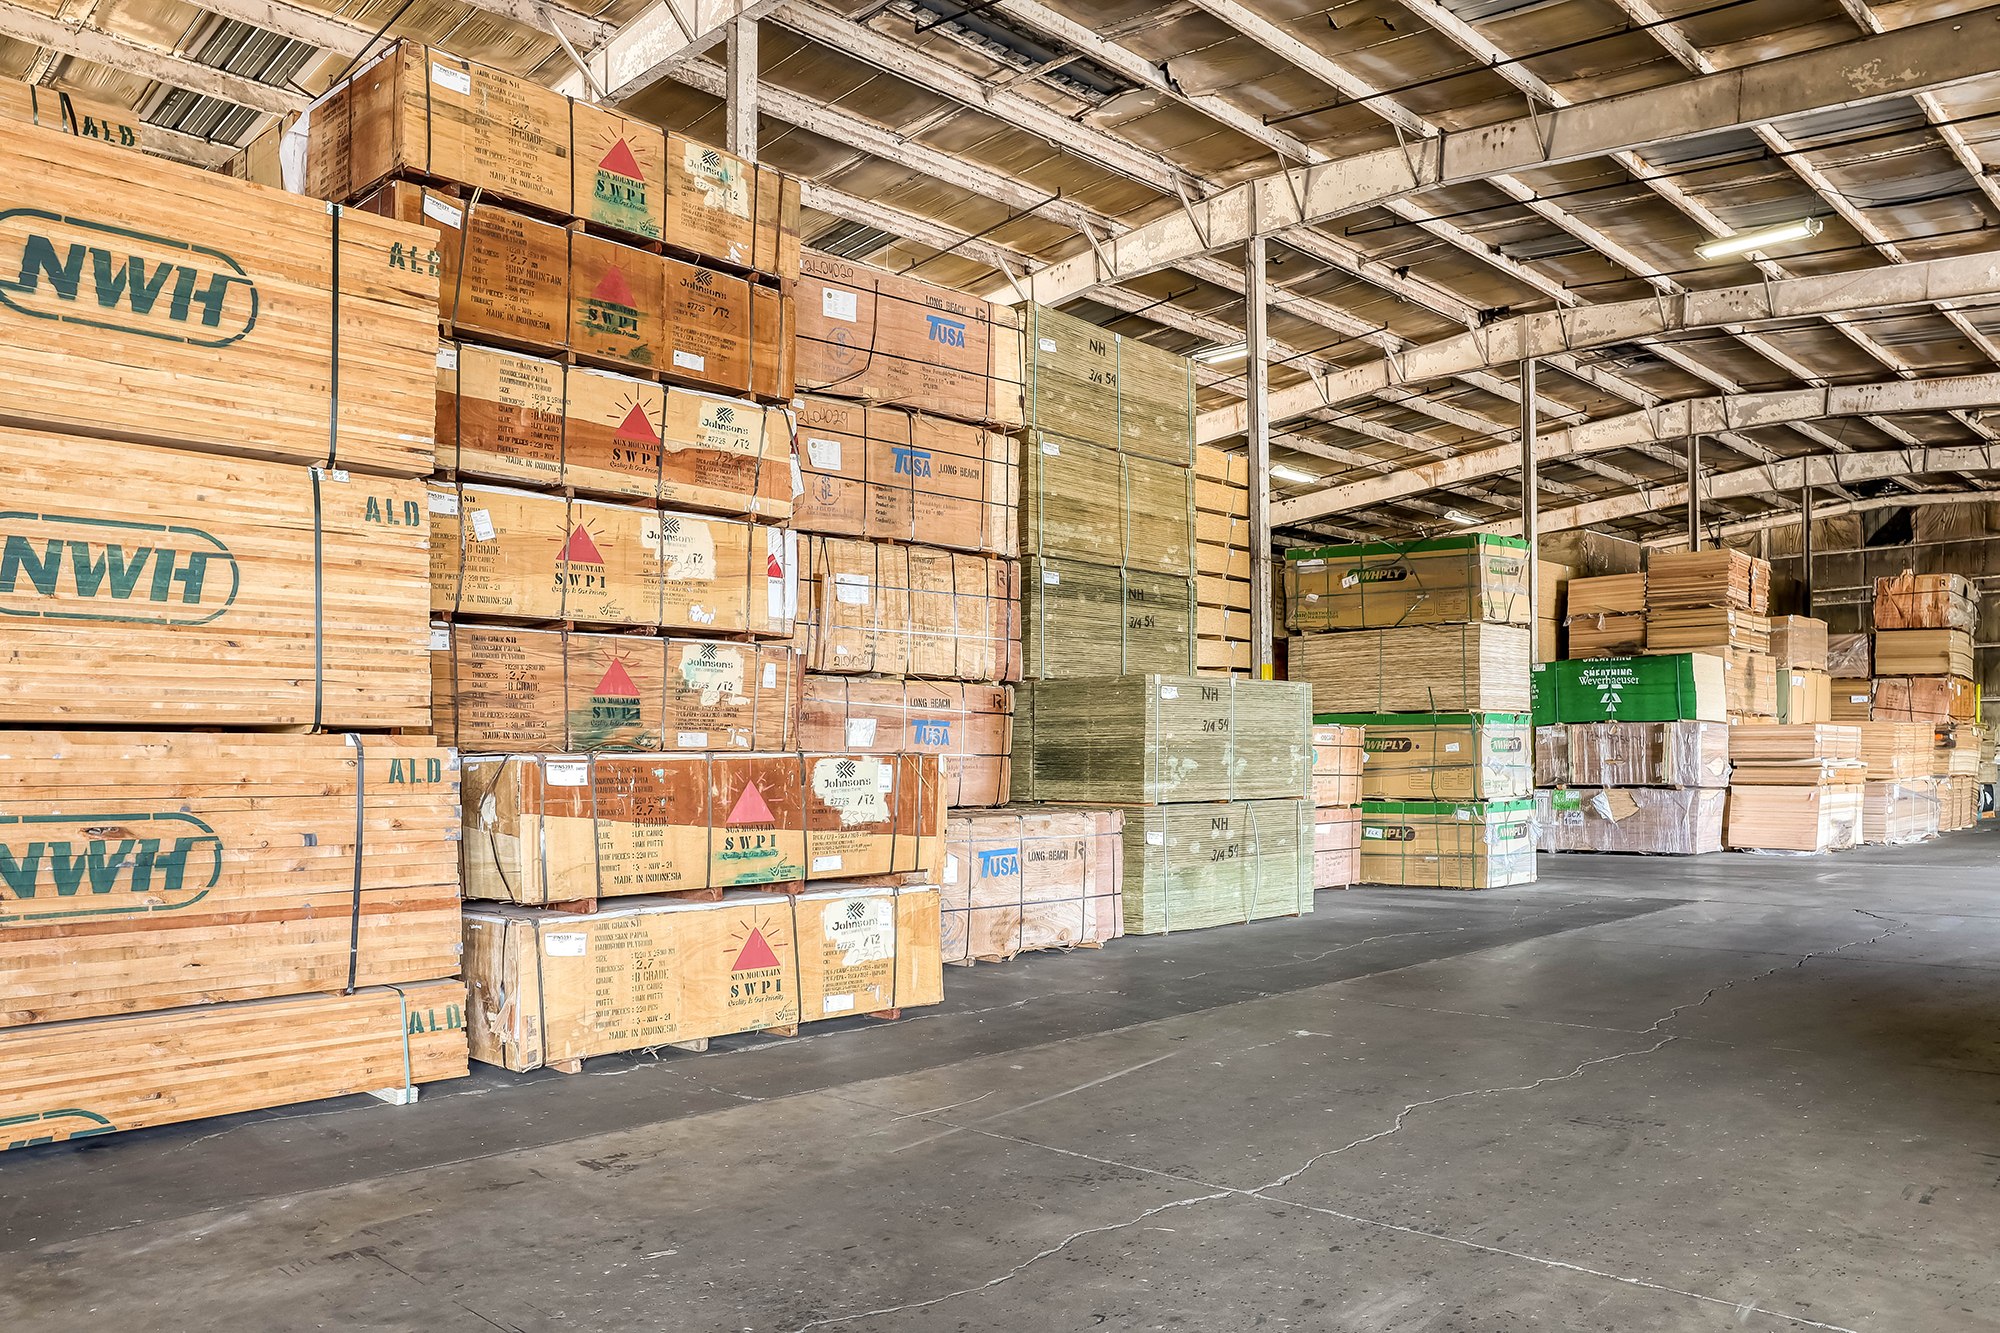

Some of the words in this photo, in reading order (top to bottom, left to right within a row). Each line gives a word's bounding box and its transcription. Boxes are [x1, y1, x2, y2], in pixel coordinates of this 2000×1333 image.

[688, 159, 734, 181] Johnsos
[18, 235, 233, 328] NWH
[926, 295, 942, 307] LONG
[486, 308, 504, 319] MADE
[516, 315, 550, 330] INDONESIA
[926, 315, 965, 348] TUSA
[1090, 339, 1106, 356] NH
[1089, 369, 1101, 383] 3/4
[1105, 372, 1116, 386] 54
[506, 456, 523, 466] MADE
[535, 461, 568, 474] INDONESA
[891, 447, 931, 478] TUSA
[939, 464, 957, 475] LONG
[960, 467, 979, 480] BEACH
[365, 496, 419, 526] ALD
[0, 535, 208, 604] NWH
[571, 564, 605, 573] MOUNTAIN
[476, 595, 512, 605] INDONESIA
[1129, 589, 1143, 600] NH
[1129, 617, 1141, 628] 3/4
[1144, 616, 1155, 627] 54
[993, 694, 1002, 708] R
[1202, 687, 1218, 701] NH
[910, 698, 928, 708] LONG
[931, 698, 951, 709] BEACH
[912, 720, 950, 745] TUSA
[1201, 719, 1215, 731] 3/4
[1218, 718, 1228, 730] 54
[389, 758, 441, 783] ALD
[1212, 818, 1228, 830] NH
[1028, 852, 1045, 862] LONG
[1048, 850, 1068, 860] BEACH
[1211, 849, 1224, 861] 3/4
[1228, 844, 1238, 857] 54
[978, 848, 1019, 878] TUSA
[614, 875, 632, 884] MADE
[636, 874, 643, 882] IN
[646, 872, 681, 882] INDONESIA
[644, 969, 669, 980] GRADE
[747, 968, 781, 979] MOUNTAIN
[409, 1003, 461, 1034] ALD
[609, 1030, 628, 1040] MADE
[631, 1029, 638, 1037] IN
[641, 1024, 677, 1036] INDONESIA
